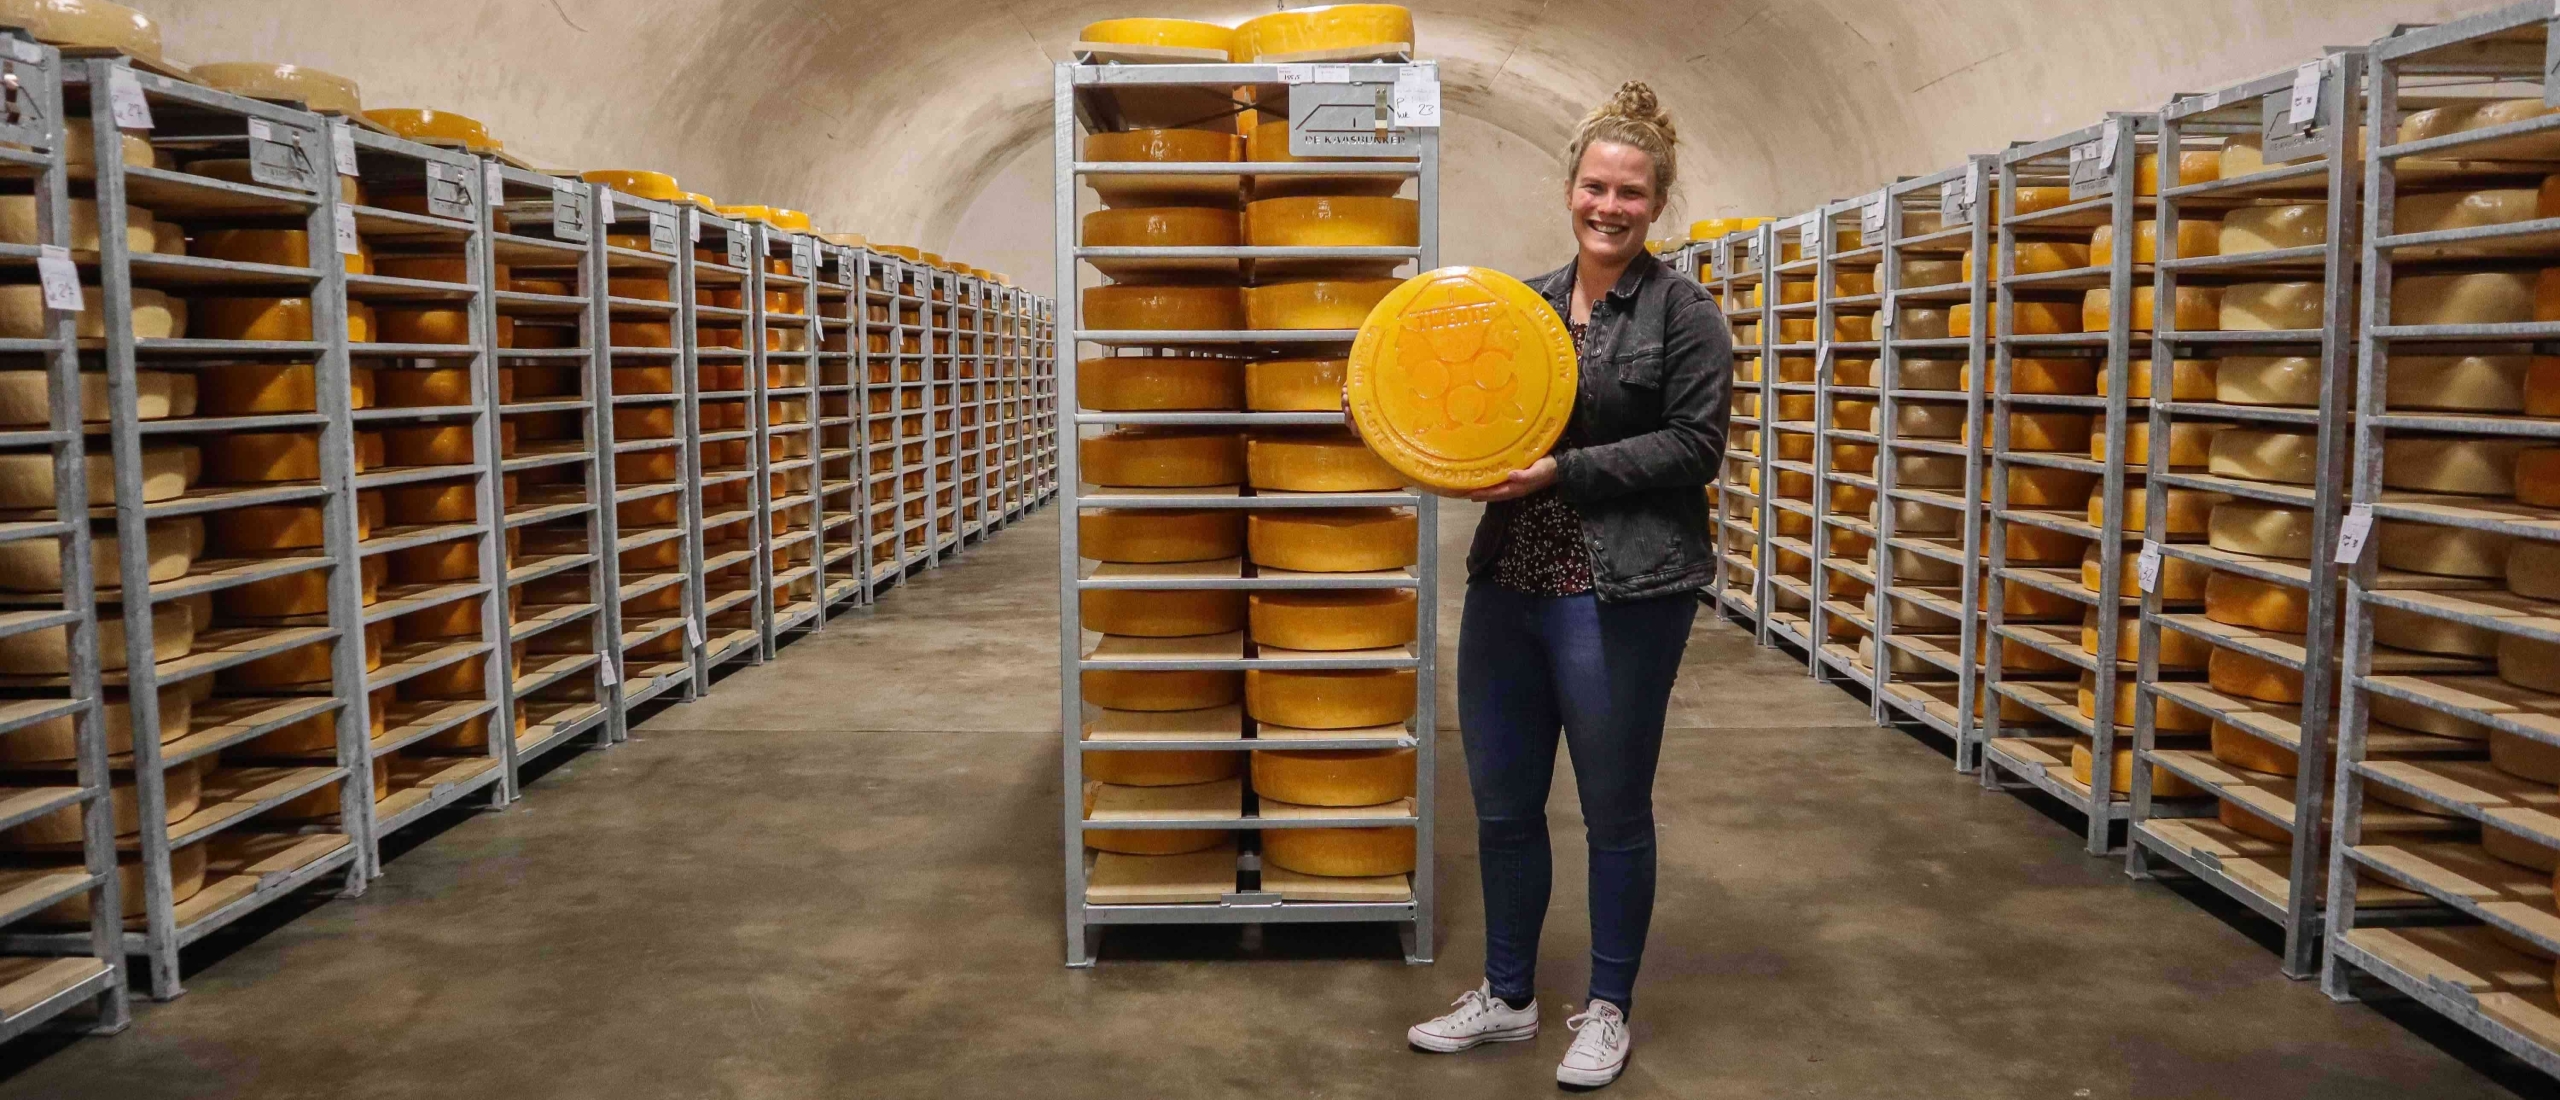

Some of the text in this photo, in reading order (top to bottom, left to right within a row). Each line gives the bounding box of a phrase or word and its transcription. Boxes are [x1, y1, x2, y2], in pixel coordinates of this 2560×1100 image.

[1418, 103, 1435, 116] 23
[1305, 135, 1406, 146] DE KAASBUNKER
[1416, 307, 1490, 331] TWENTE
